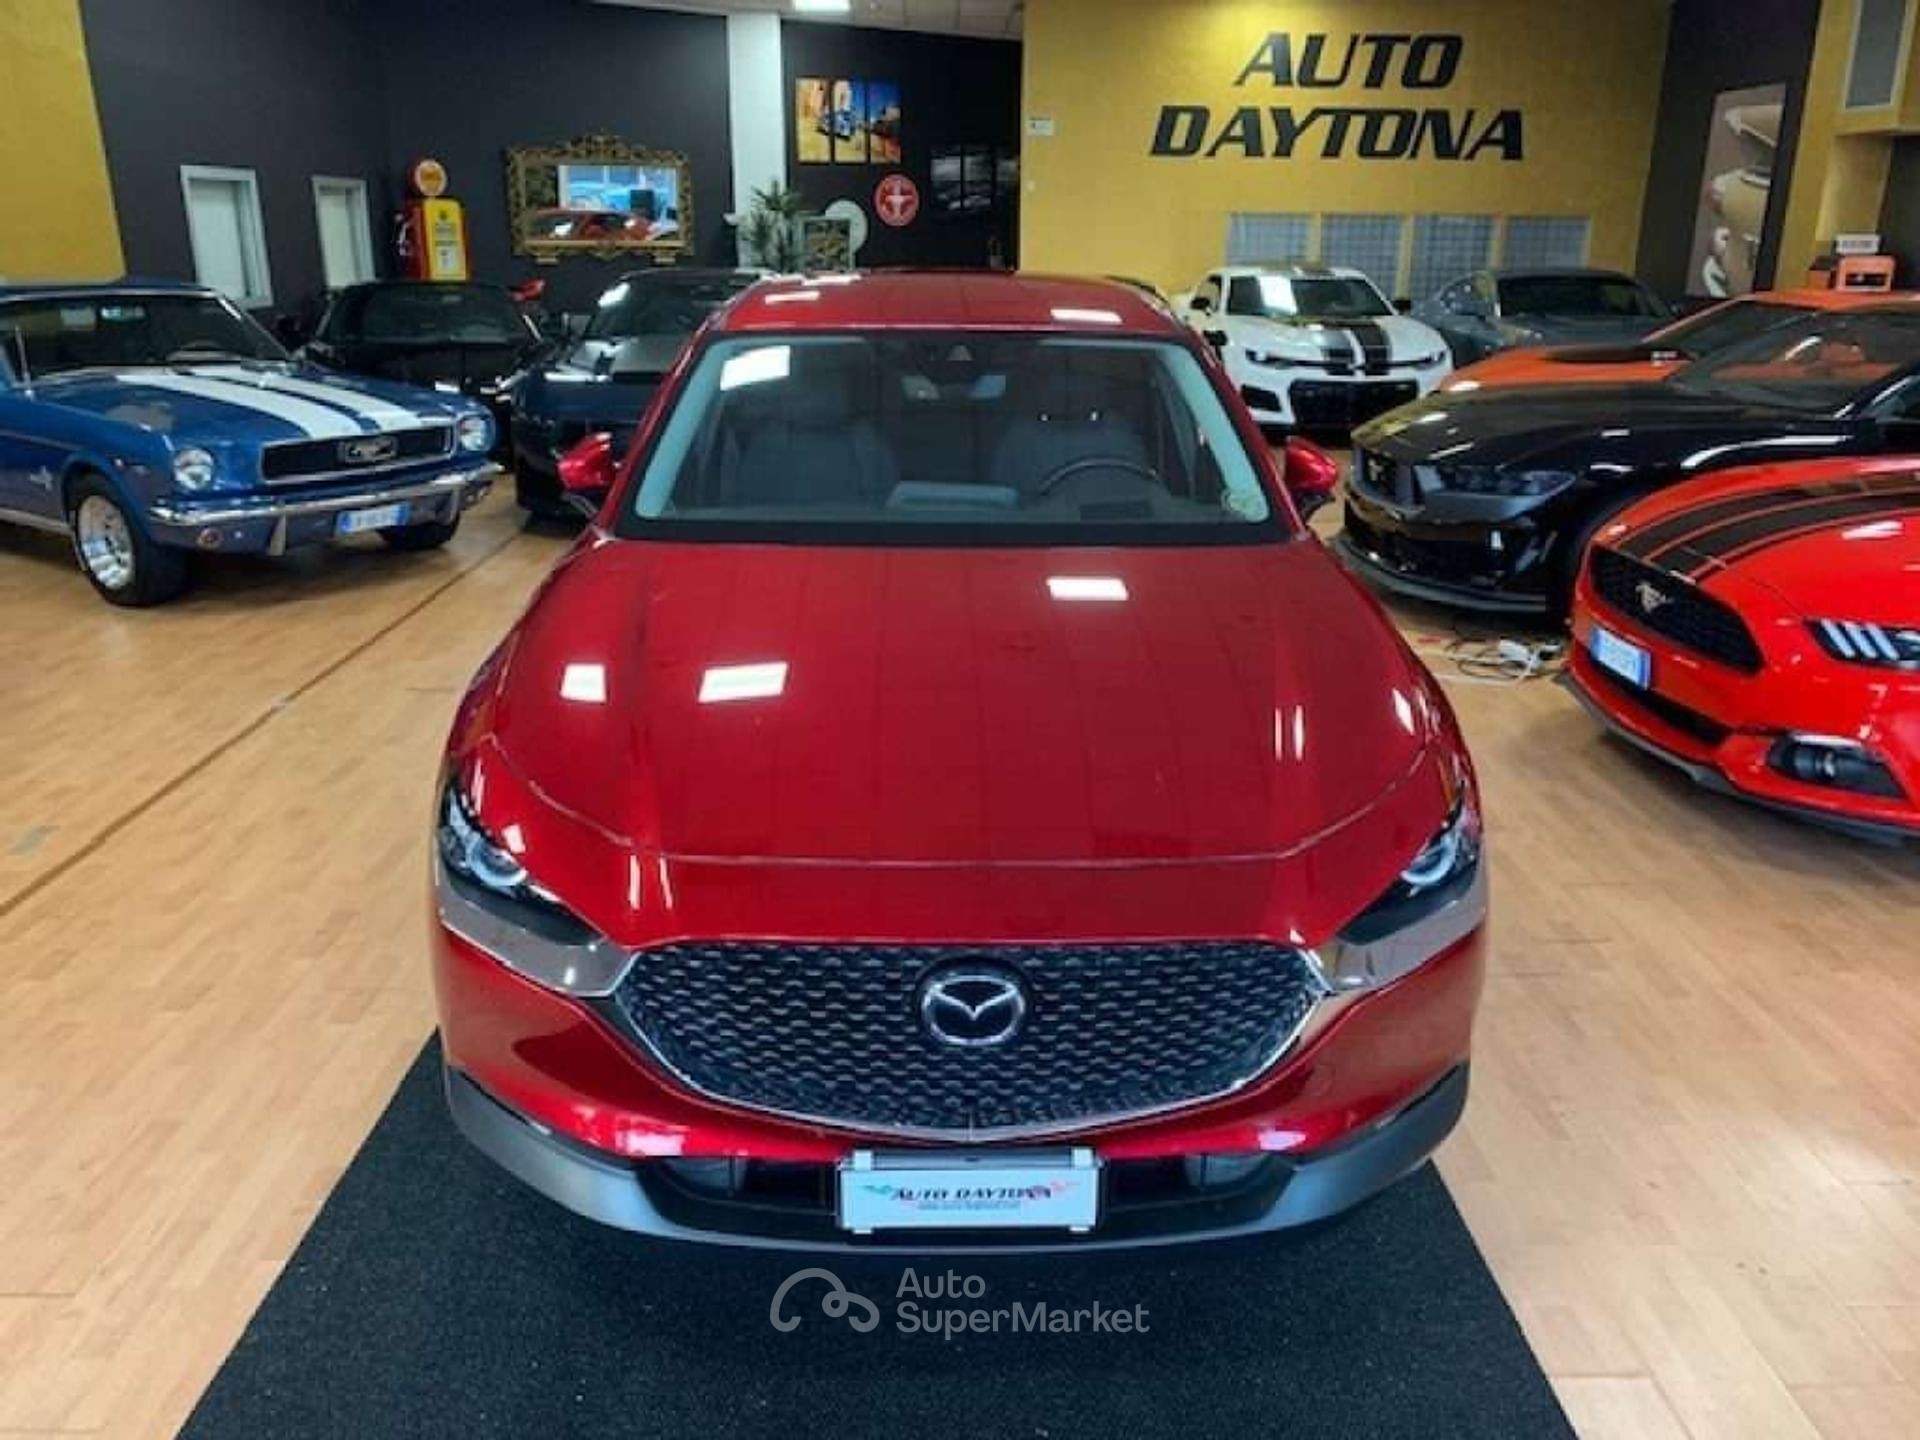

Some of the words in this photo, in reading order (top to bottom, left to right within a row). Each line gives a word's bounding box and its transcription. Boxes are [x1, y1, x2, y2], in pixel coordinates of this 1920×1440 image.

[1233, 32, 1464, 88] AUTO
[1150, 104, 1524, 161] DAYTONA
[892, 1186, 949, 1200] AUTO
[955, 1186, 1052, 1200] DAYTONA
